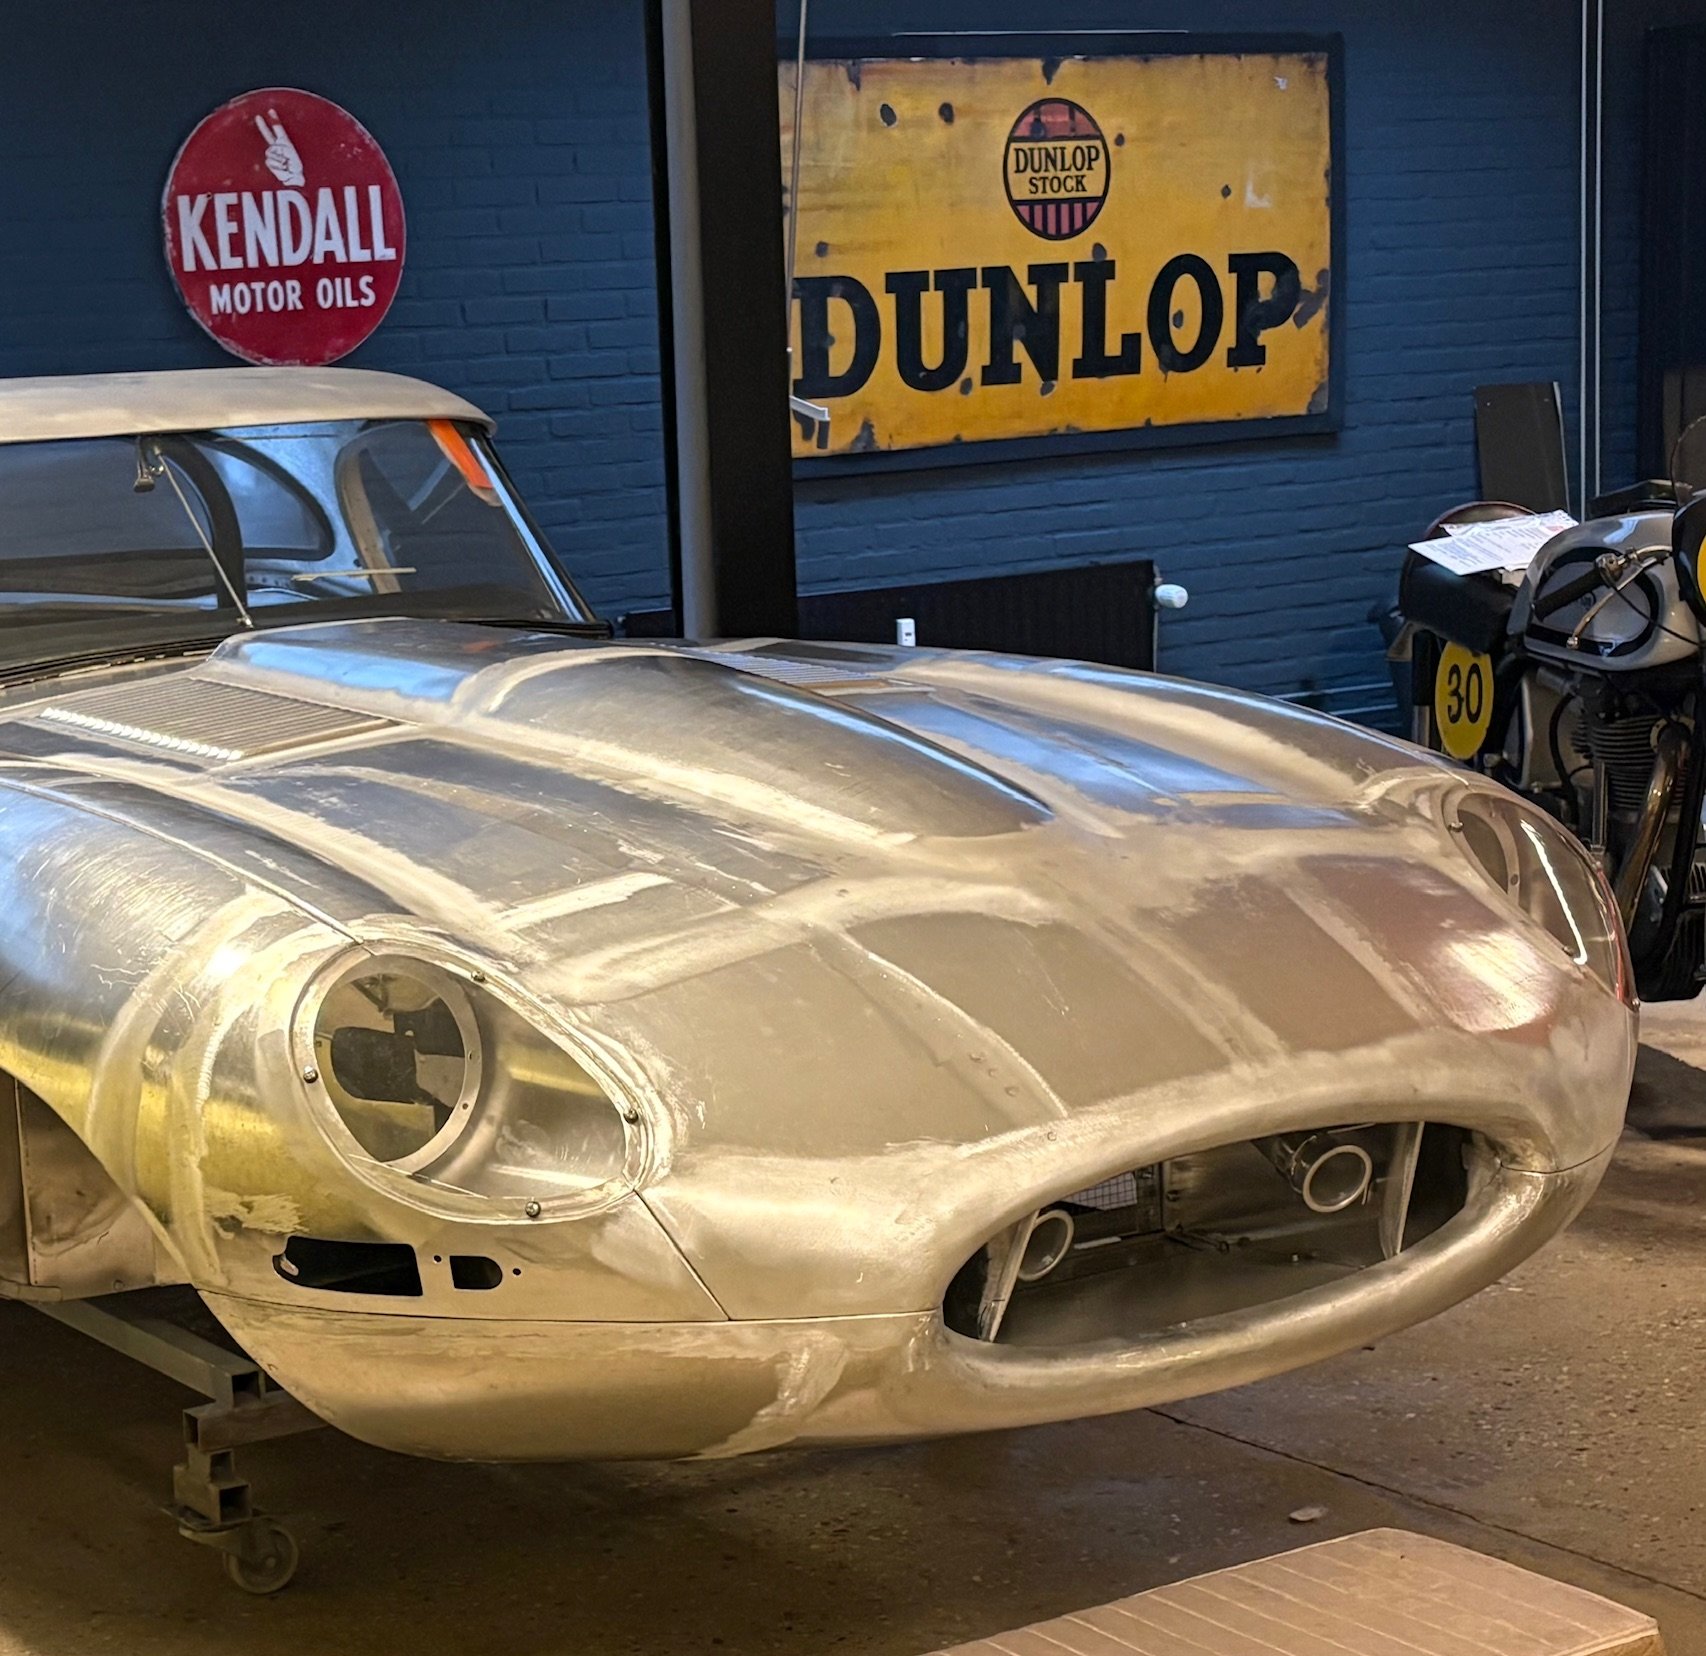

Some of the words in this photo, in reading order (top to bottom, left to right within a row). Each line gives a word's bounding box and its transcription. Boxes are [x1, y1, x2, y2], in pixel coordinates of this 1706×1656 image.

[1013, 145, 1100, 173] DUNLOP
[1028, 175, 1087, 194] STOCK
[176, 185, 396, 272] KENDALL
[209, 279, 304, 315] MOTOR
[316, 275, 376, 310] OILS
[791, 251, 1300, 399] DUNLOP
[1447, 663, 1483, 724] 30
